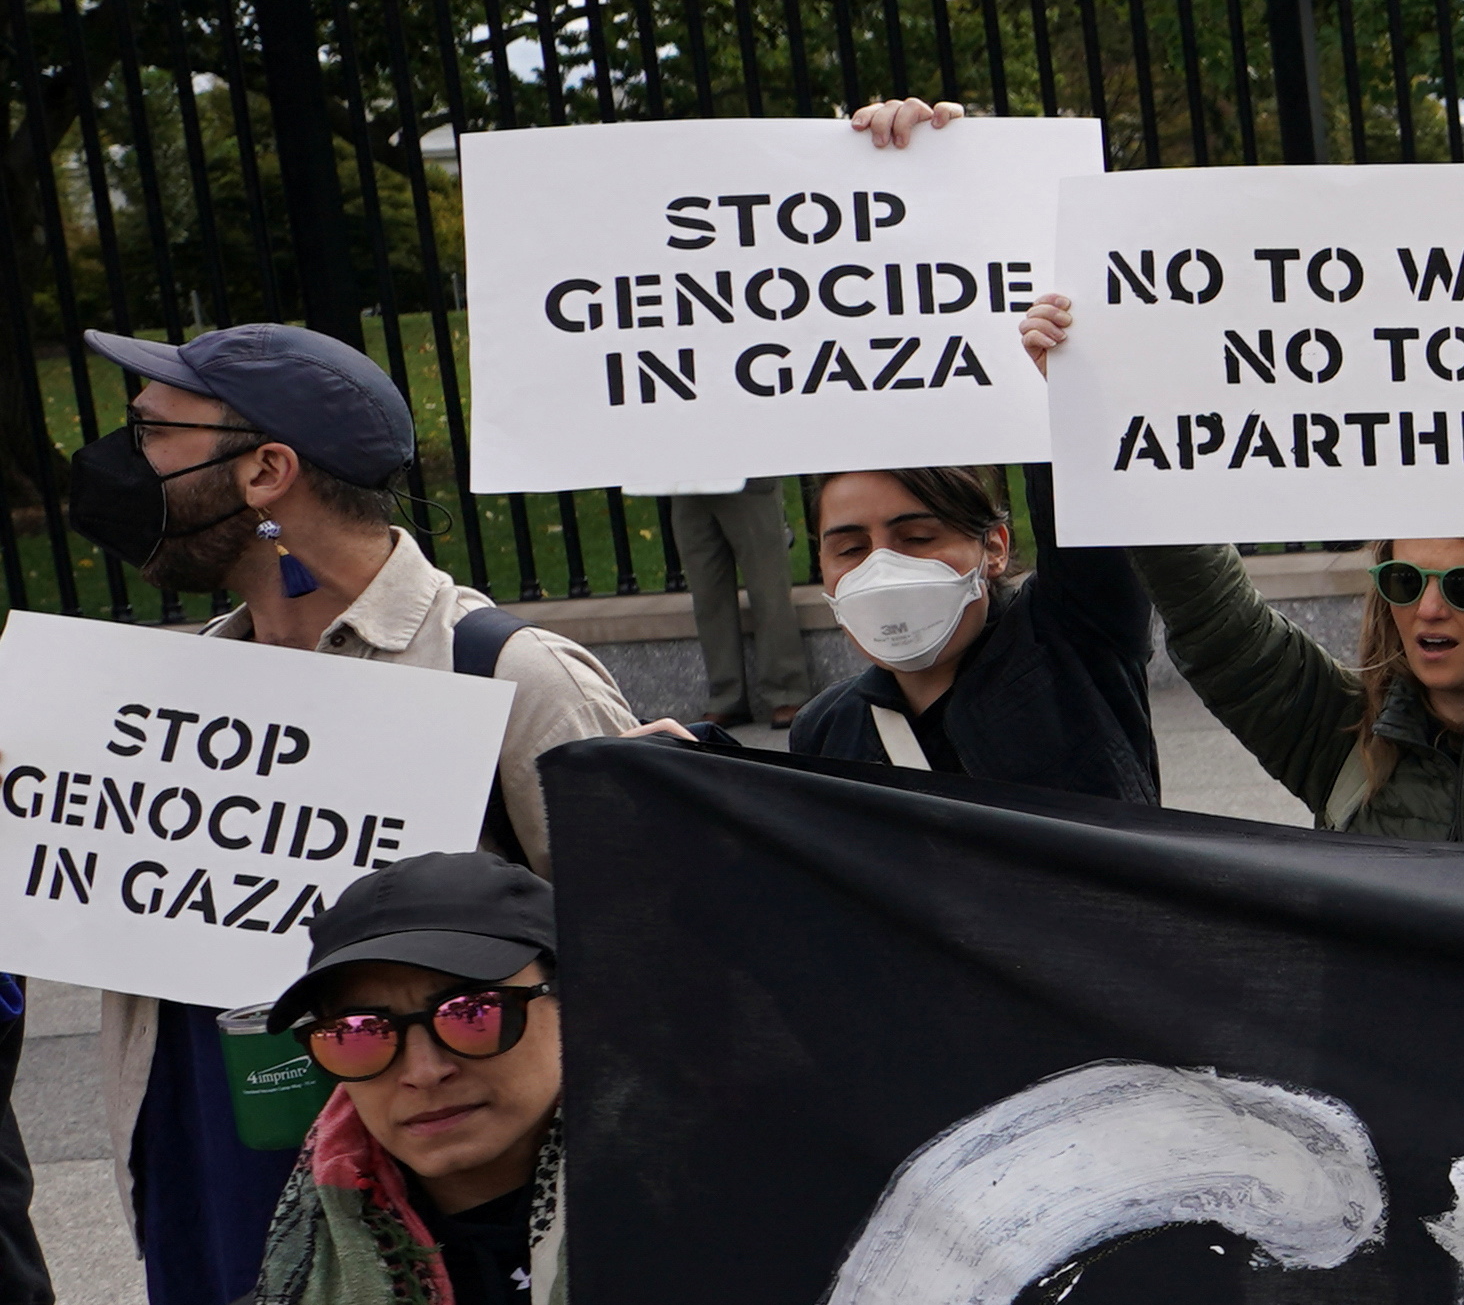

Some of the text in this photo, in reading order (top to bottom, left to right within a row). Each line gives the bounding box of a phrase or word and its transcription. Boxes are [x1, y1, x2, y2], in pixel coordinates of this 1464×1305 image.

[666, 191, 907, 251] STOP
[545, 262, 1034, 333] GENOCIDE
[1107, 248, 1224, 305] NO
[1254, 247, 1364, 303] TO
[606, 335, 993, 407] IN GAZA
[1224, 328, 1343, 385] NO
[880, 621, 909, 636] 3M
[106, 703, 311, 777] STOP
[2, 764, 405, 870] GENOCIDE
[25, 843, 328, 935] IN GAZA
